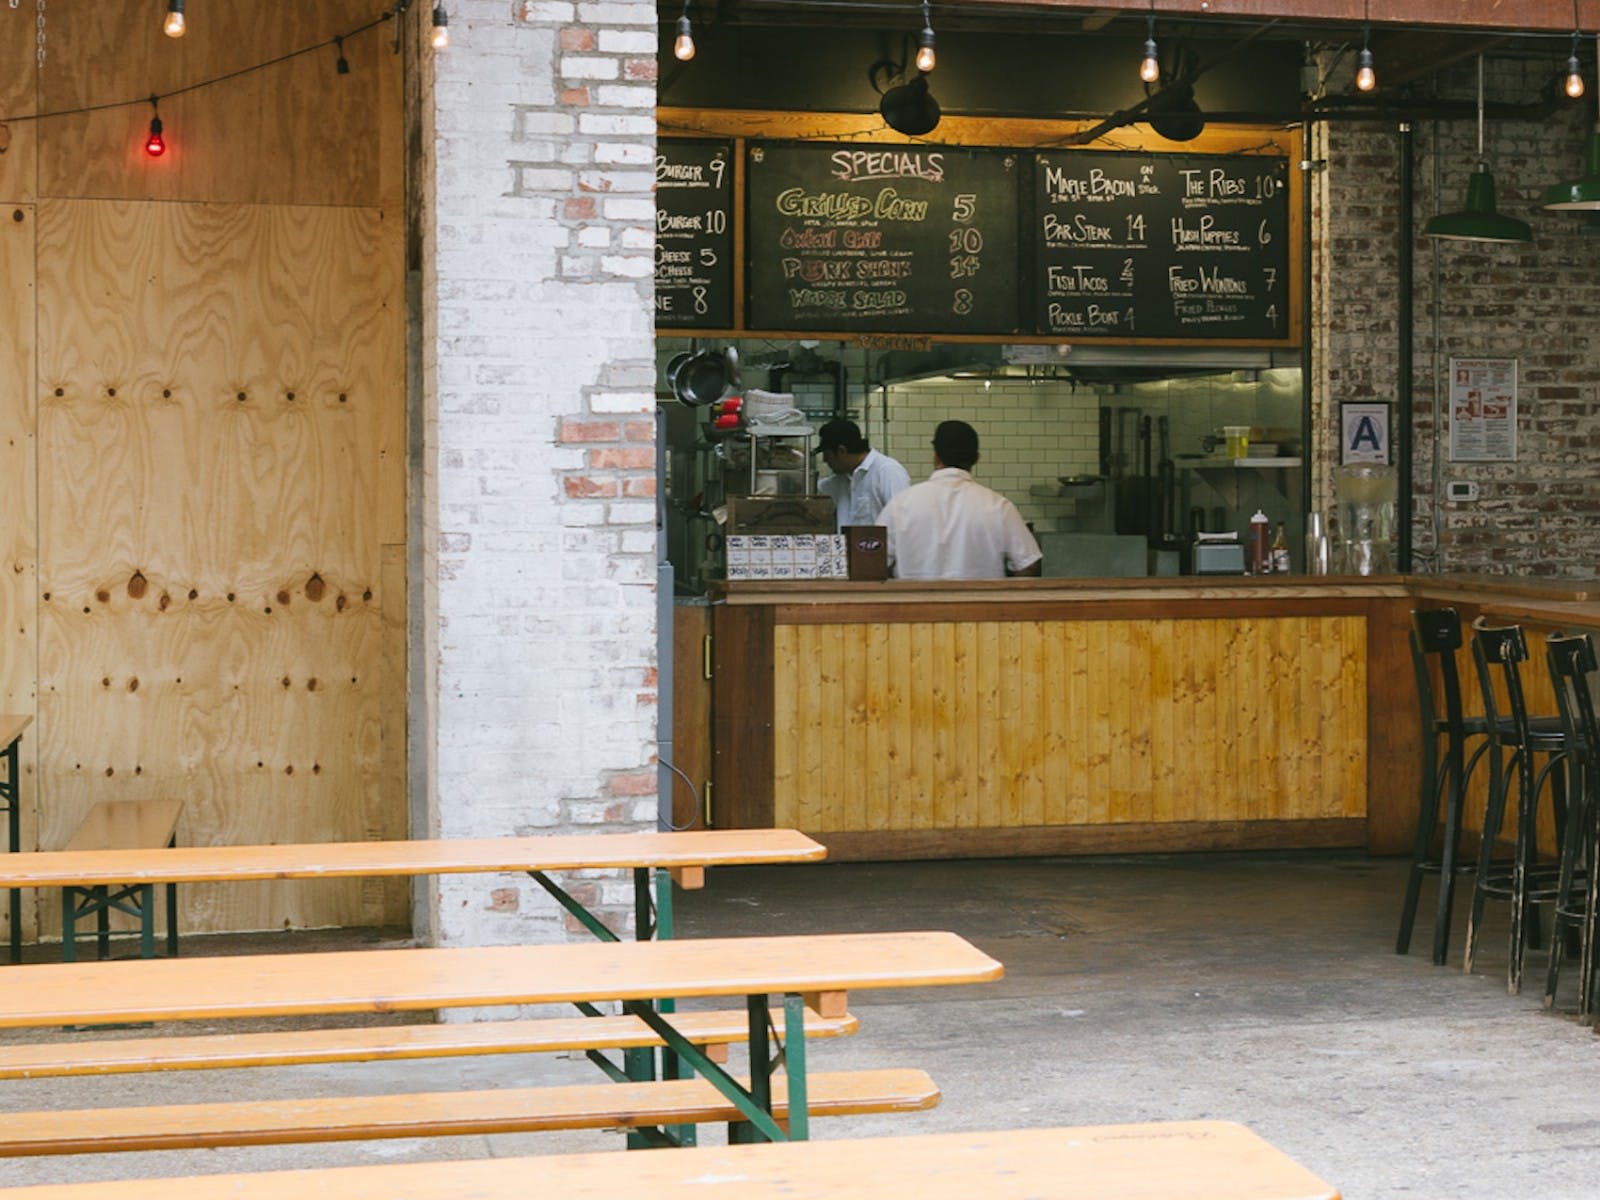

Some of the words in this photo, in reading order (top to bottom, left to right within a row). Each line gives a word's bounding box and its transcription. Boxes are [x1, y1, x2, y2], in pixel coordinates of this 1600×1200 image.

[655, 155, 703, 180] BURGER
[709, 158, 726, 189] 9
[831, 151, 944, 176] SPECIALS
[1046, 167, 1088, 197] MAPLE
[1090, 168, 1136, 197] BACON
[1178, 170, 1205, 197] THE
[1210, 168, 1246, 198] RIBS
[1256, 175, 1274, 199] 10
[776, 187, 874, 220] GRILLED
[874, 187, 928, 222] CORN
[952, 194, 977, 223] 5
[657, 209, 702, 232] BURGER
[705, 210, 726, 235] 10
[1043, 214, 1073, 241] BAR
[1073, 214, 1112, 242] STEAK
[1126, 214, 1148, 241] 14
[1200, 215, 1240, 244] PUPPIES
[1258, 219, 1272, 244] 6
[949, 227, 983, 254] 10
[700, 248, 717, 266] 5
[950, 256, 980, 280] 14
[1048, 266, 1076, 290] FISH
[1072, 265, 1109, 291] TACOS
[1168, 265, 1199, 292] FRIED
[1262, 267, 1277, 292] 7
[692, 286, 708, 314] 8
[852, 290, 907, 310] SALAD
[953, 288, 974, 315] 8
[1124, 307, 1136, 331] 4
[1265, 304, 1279, 329] 4
[1351, 416, 1380, 450] A
